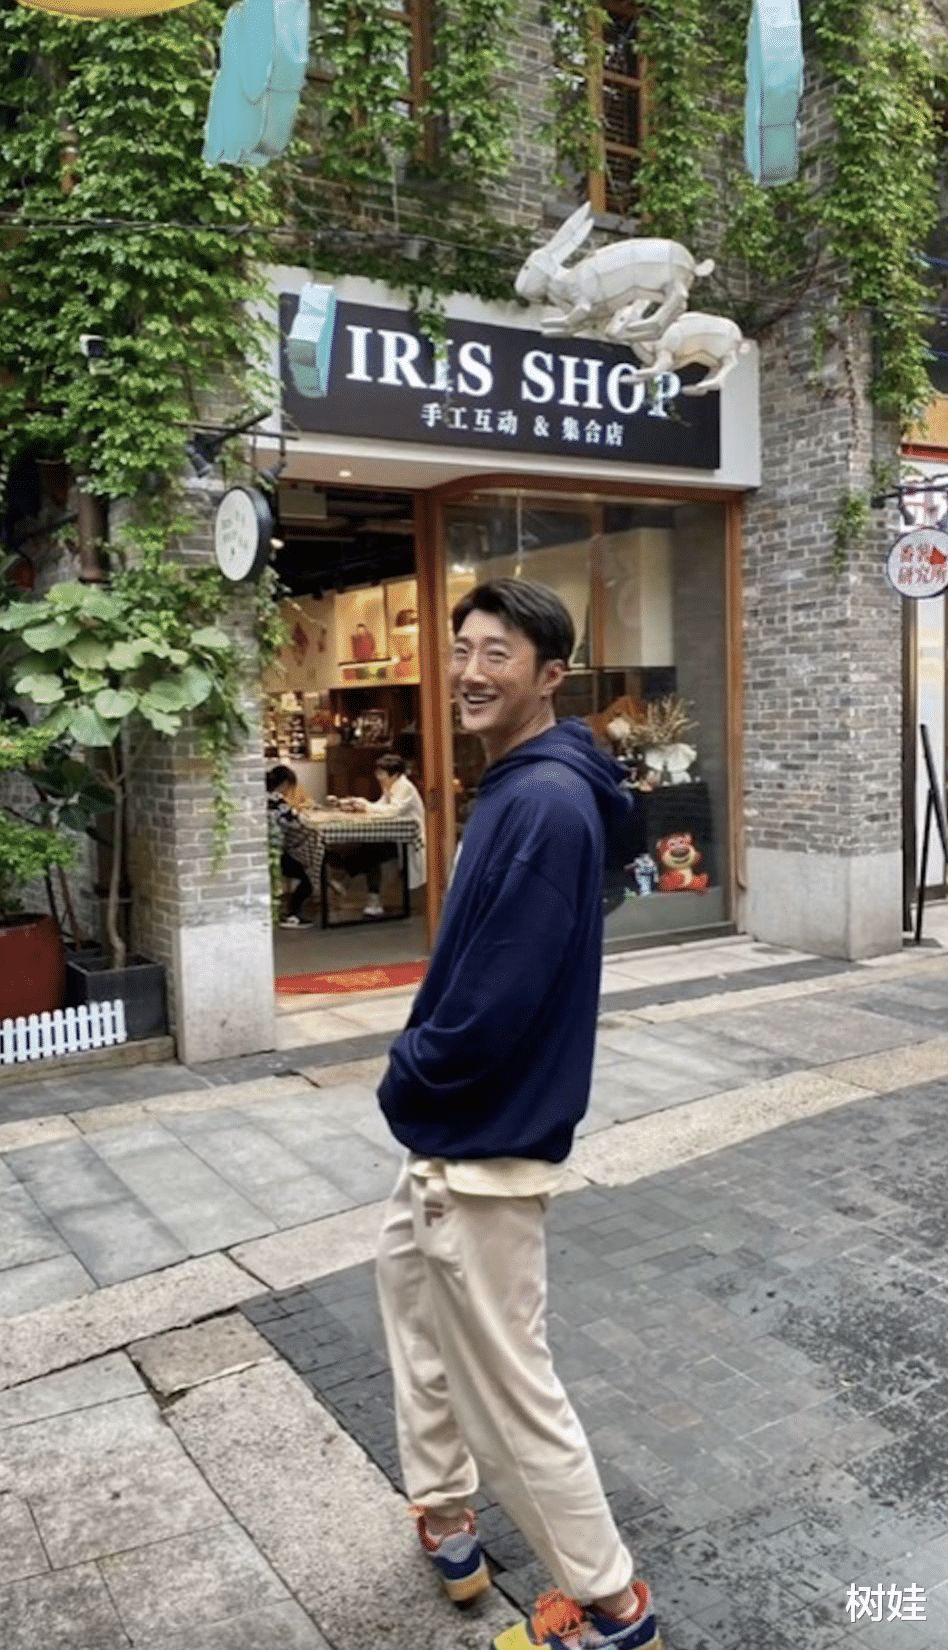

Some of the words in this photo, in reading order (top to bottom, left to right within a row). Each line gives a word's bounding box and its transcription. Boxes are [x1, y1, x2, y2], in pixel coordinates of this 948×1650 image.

[345, 325, 493, 397] IRIS
[521, 349, 681, 417] SHOP
[421, 402, 518, 436] 手工互动
[533, 415, 550, 437] &
[562, 416, 624, 447] 集合店
